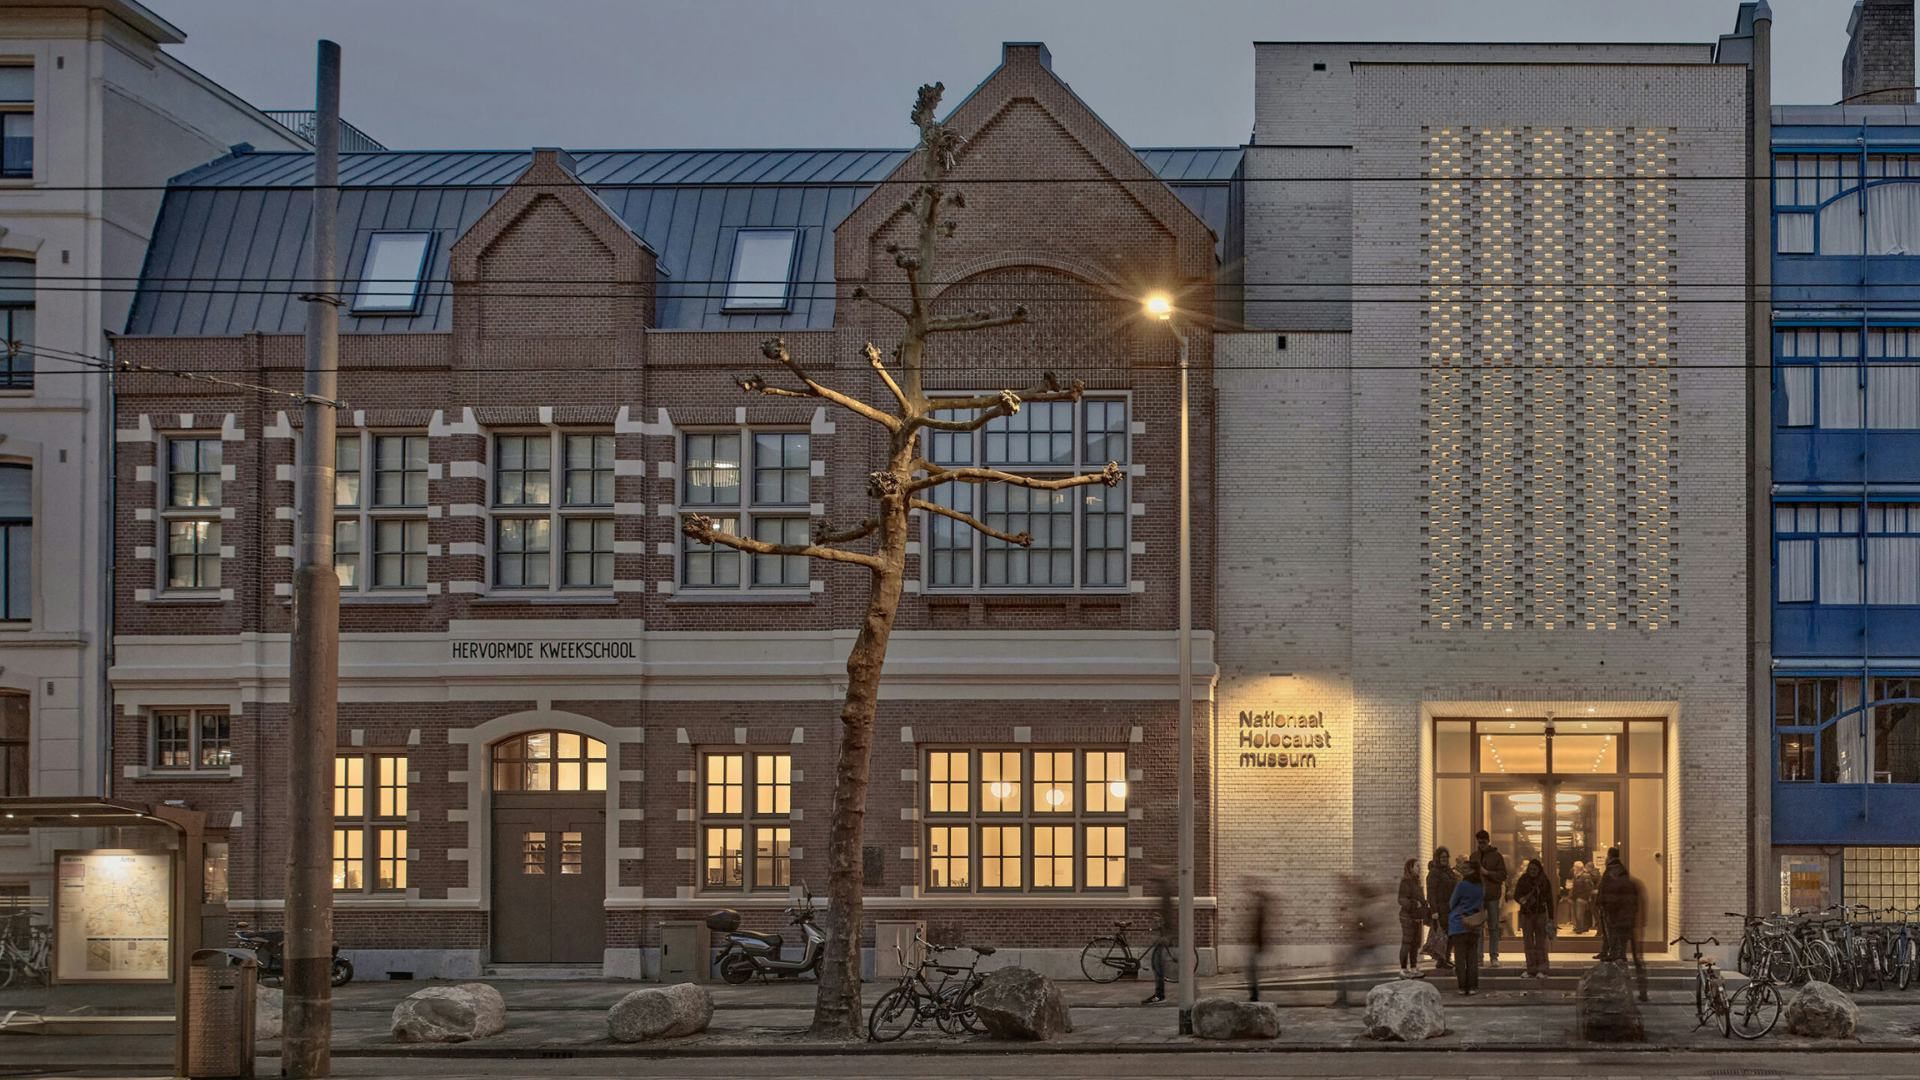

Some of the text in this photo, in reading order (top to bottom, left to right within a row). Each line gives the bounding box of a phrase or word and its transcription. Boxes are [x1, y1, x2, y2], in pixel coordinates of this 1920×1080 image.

[452, 642, 636, 659] HERVORMDE KWEEKSCHOOL
[1239, 710, 1324, 728] Nationaal
[1239, 730, 1332, 748] Holocaust
[1239, 752, 1316, 768] museum
